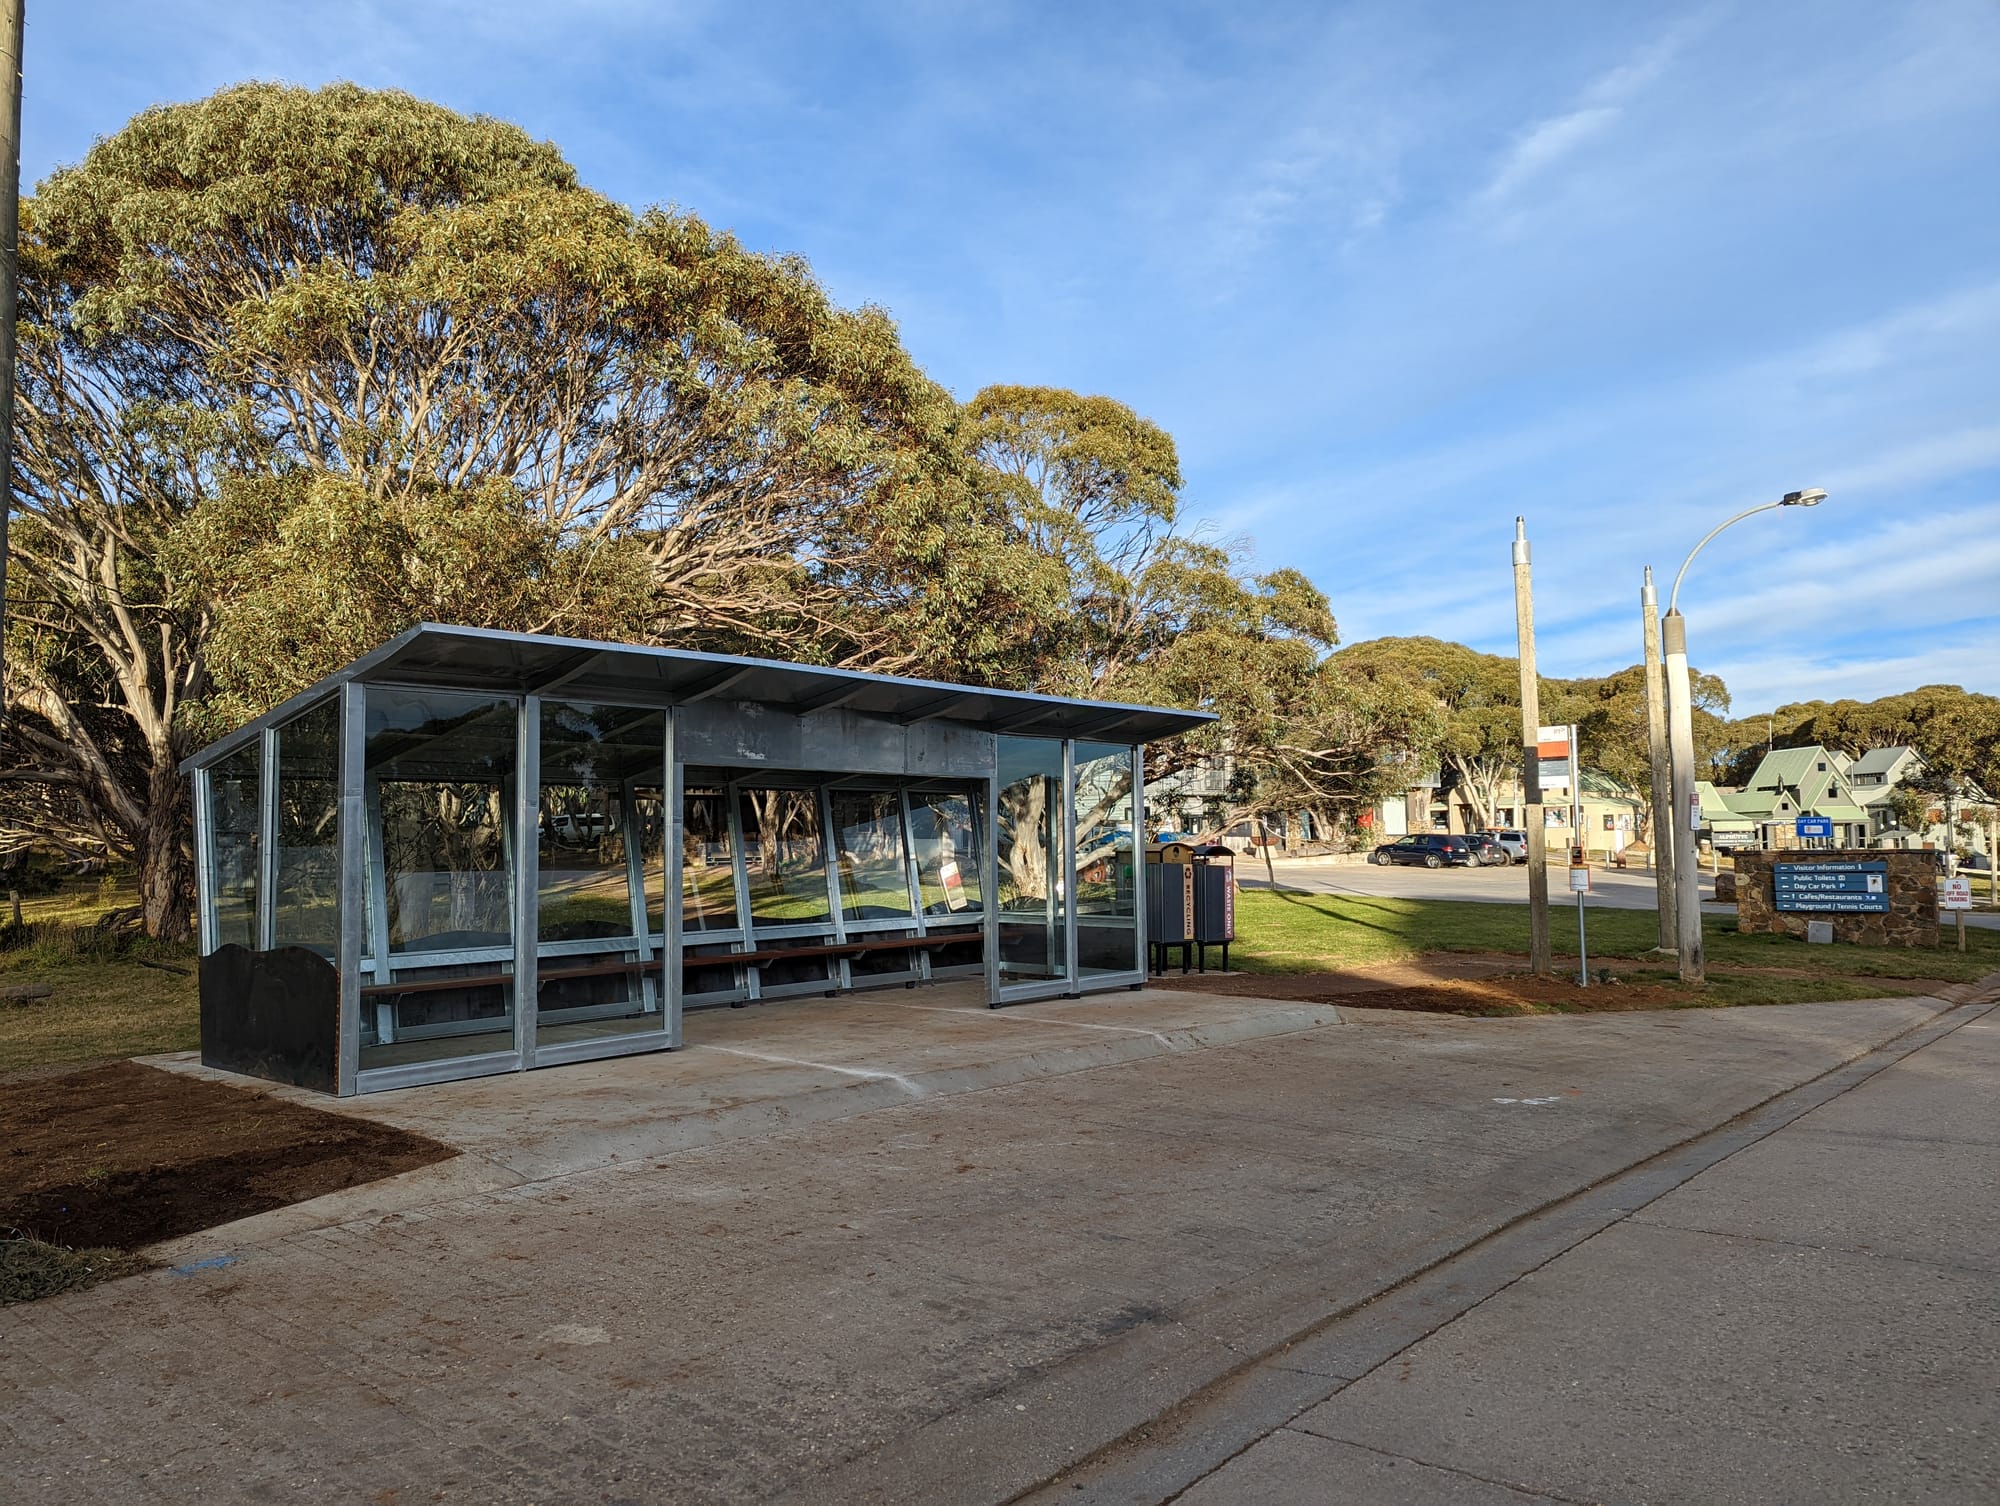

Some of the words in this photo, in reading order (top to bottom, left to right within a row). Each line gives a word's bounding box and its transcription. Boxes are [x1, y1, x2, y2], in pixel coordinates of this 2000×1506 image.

[1816, 863, 1856, 871] Information
[1798, 893, 1862, 901] Cafes/Restaurants
[1795, 903, 1832, 911] Playground
